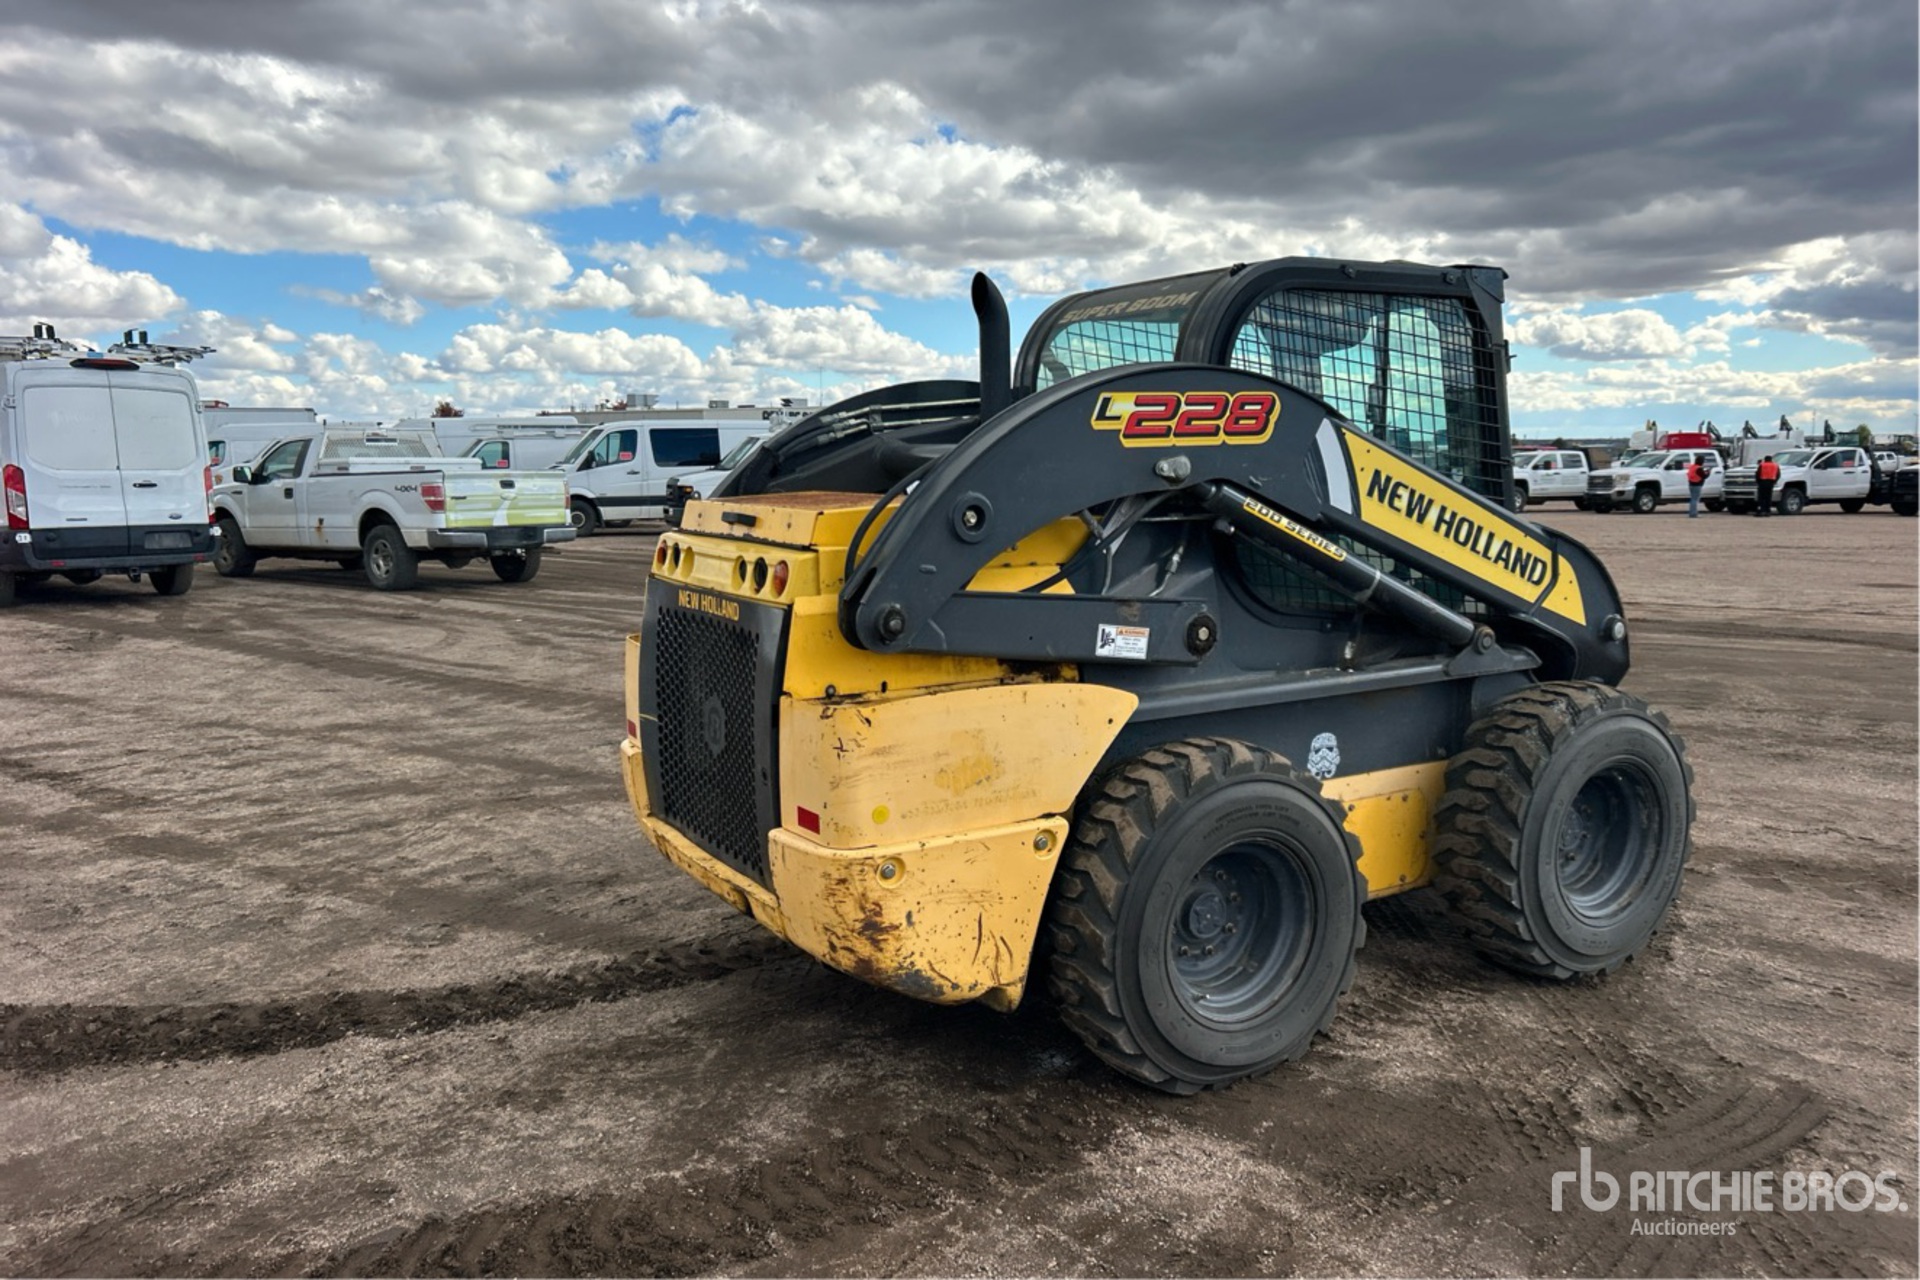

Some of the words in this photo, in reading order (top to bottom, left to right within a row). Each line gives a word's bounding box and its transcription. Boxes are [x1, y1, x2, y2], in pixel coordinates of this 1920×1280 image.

[1058, 301, 1131, 325] SUPER
[1125, 291, 1200, 313] BOOM
[1094, 393, 1279, 441] L228
[1246, 499, 1282, 524] 200
[1284, 519, 1344, 558] SERIES
[1366, 468, 1435, 525] NEW
[1433, 504, 1548, 587] HOLLAND
[678, 588, 700, 610] NEW
[700, 593, 740, 622] HOLLAND
